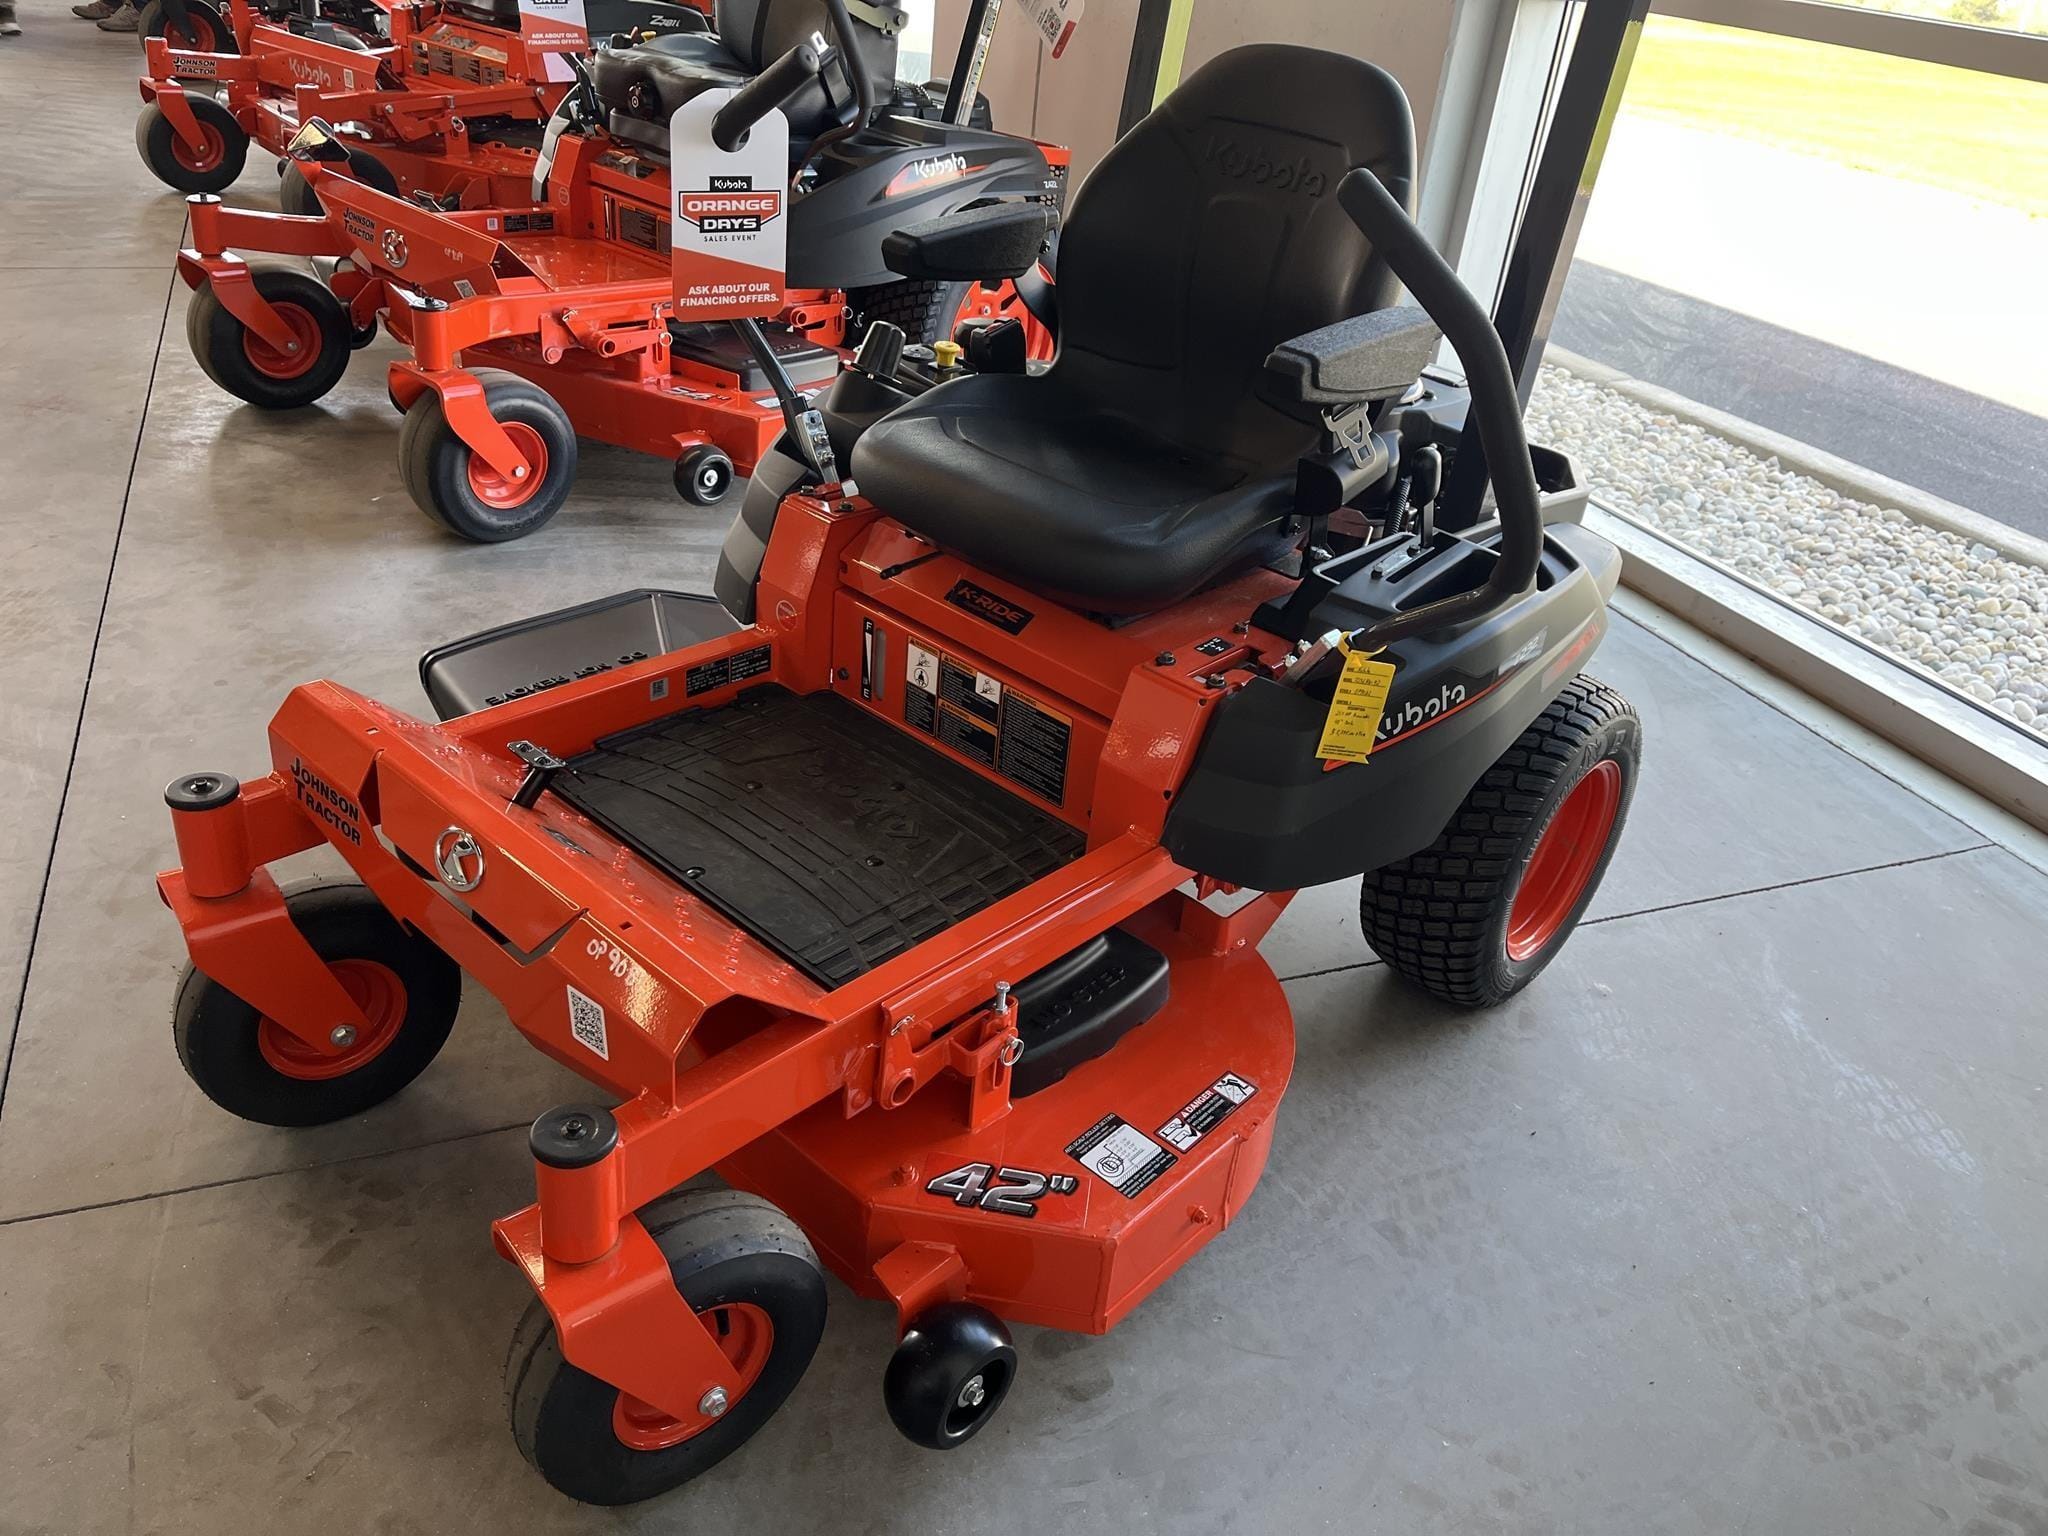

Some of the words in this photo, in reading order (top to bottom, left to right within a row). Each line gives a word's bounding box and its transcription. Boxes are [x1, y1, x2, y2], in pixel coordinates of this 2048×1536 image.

[173, 58, 216, 67] JOHNSON
[175, 65, 216, 75] TRACTOR
[288, 58, 332, 88] Kubota
[913, 152, 967, 178] Kubota
[1200, 136, 1327, 198] Kubota
[714, 179, 748, 190] Kubota
[687, 199, 774, 212] ORANGE
[343, 207, 376, 230] JOHNSON
[703, 217, 757, 231] DAYS
[344, 219, 375, 243] TRACTOR
[731, 234, 756, 242] EVENT
[688, 285, 710, 295] ASK
[711, 283, 747, 294] ABOUT
[748, 283, 770, 292] OUR
[680, 296, 738, 307] FINANCING
[738, 292, 780, 303] OFFERS.
[956, 586, 1025, 624] K-RIDE
[866, 621, 873, 630] F
[617, 651, 648, 664] DO
[574, 662, 612, 679] NOT
[485, 675, 570, 707] REMOVE
[863, 688, 870, 699] E
[290, 756, 360, 822] JOHNSON
[294, 777, 362, 847] TRACTOR
[1186, 1089, 1214, 1115] DANGER
[925, 1162, 1080, 1218] 42"
